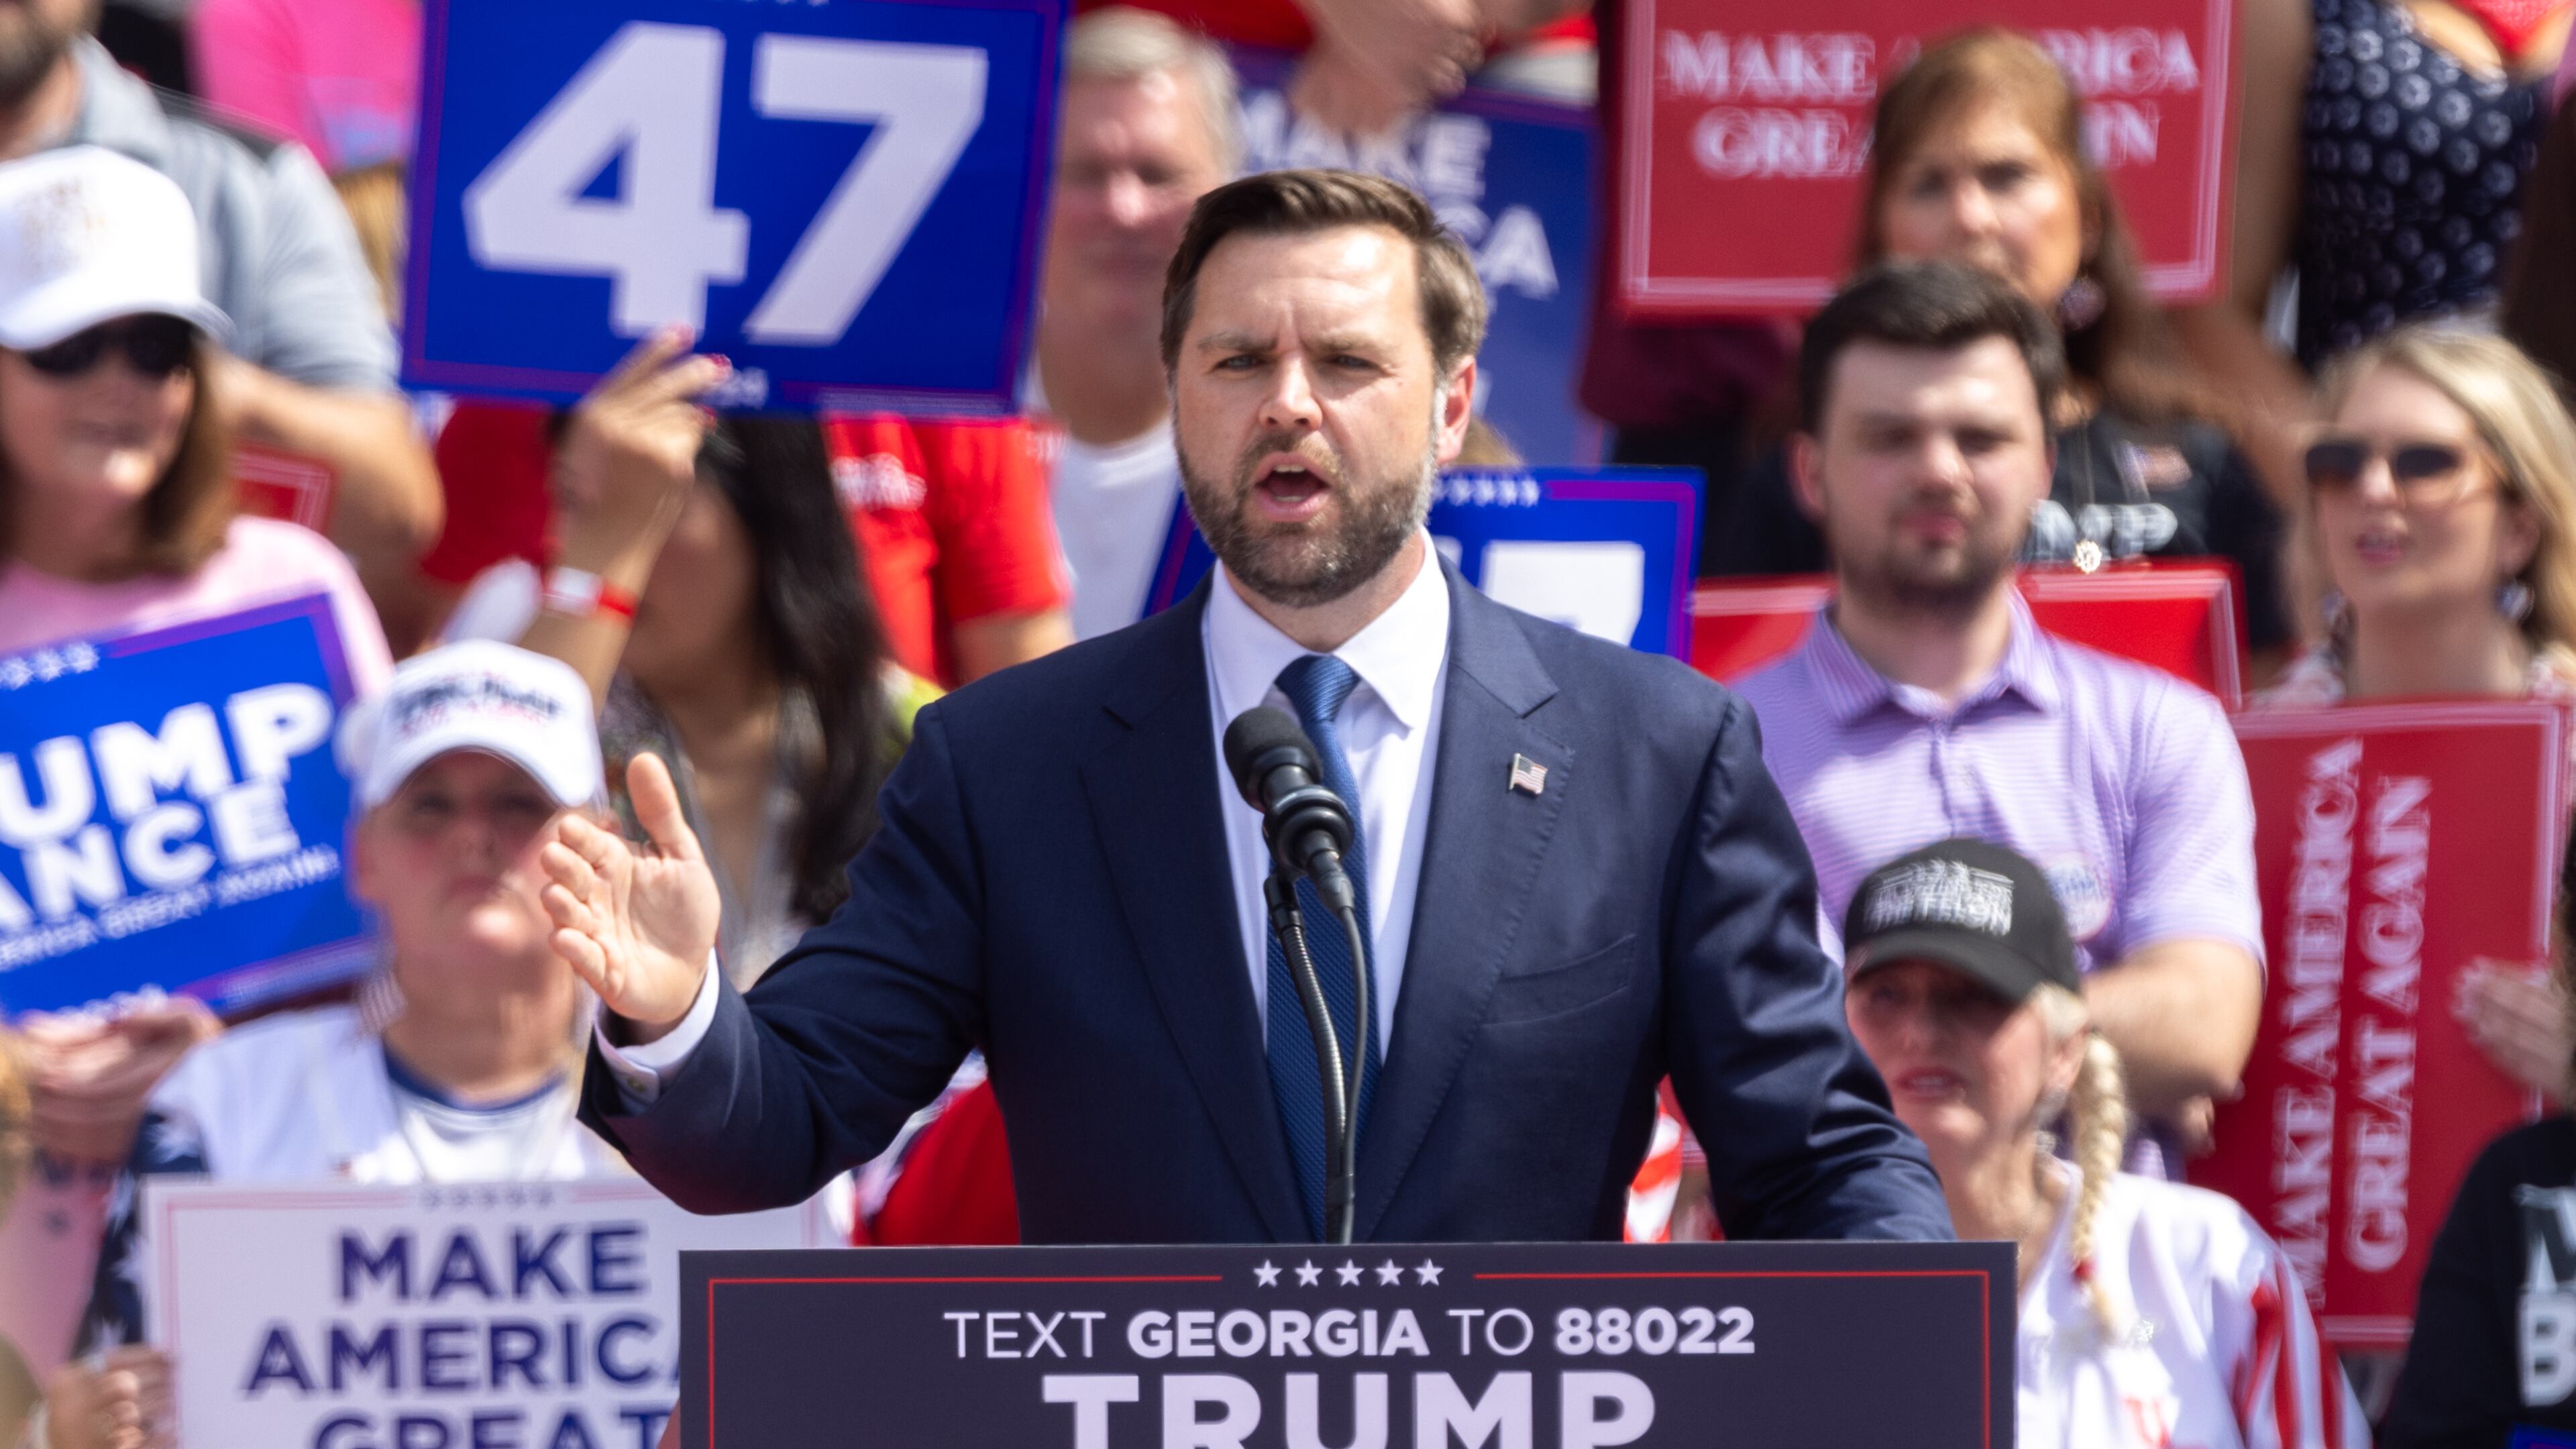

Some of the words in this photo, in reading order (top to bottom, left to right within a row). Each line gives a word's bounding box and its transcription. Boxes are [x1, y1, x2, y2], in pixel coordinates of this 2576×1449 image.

[1662, 30, 1877, 102] MAKE
[1690, 105, 1877, 178] GRE
[463, 20, 989, 347] 47
[2344, 1014, 2418, 1273] GREAT
[332, 1218, 649, 1305] MAKE
[240, 1311, 680, 1399] AMERIC
[943, 1311, 1107, 1359] TEXT
[1127, 1309, 1430, 1359] GEORGIA
[1446, 1307, 1535, 1356] TO
[1555, 1306, 1756, 1355] 88022
[1042, 1371, 1656, 1449] TRUMP
